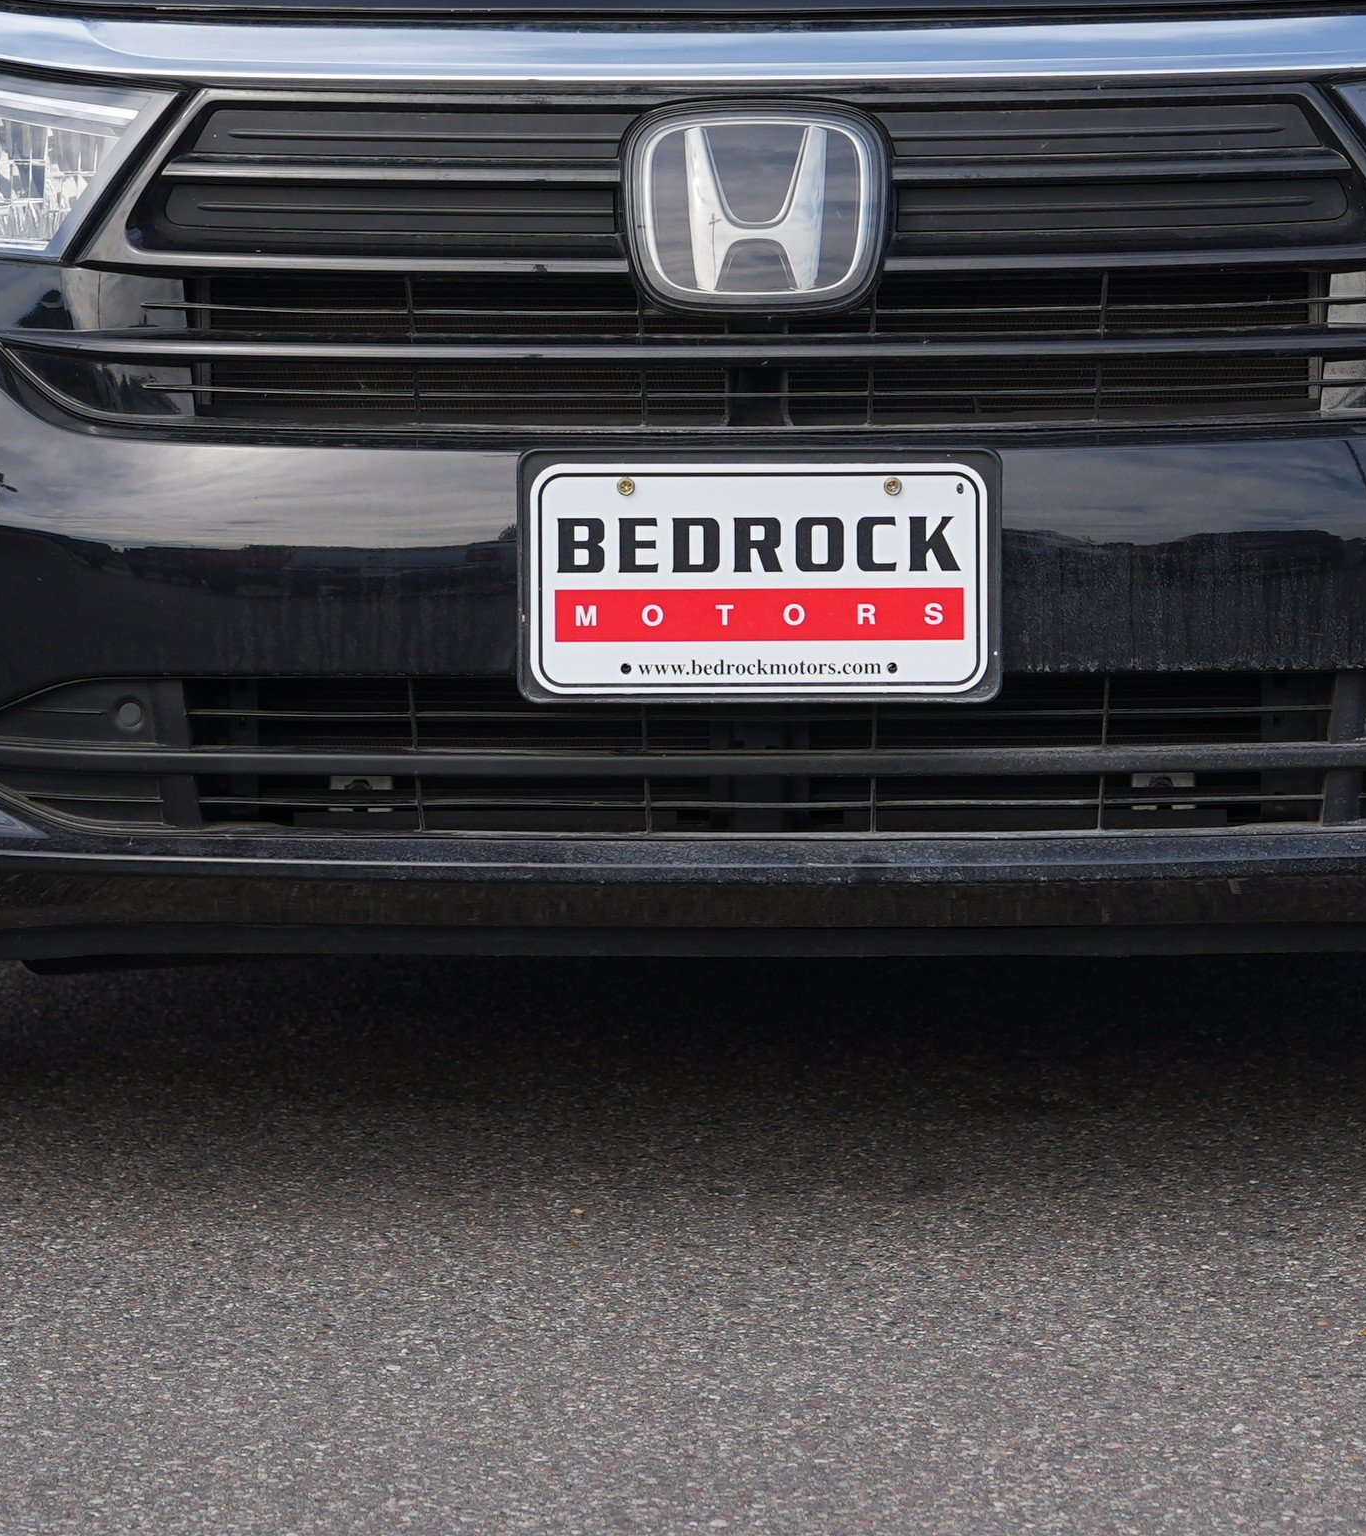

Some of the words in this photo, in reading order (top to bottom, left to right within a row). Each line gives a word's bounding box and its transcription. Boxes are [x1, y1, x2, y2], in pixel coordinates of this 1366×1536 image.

[556, 516, 962, 573] BEDROCK
[575, 602, 945, 627] MOTORS
[637, 659, 882, 677] www.bedrockmotors.com
